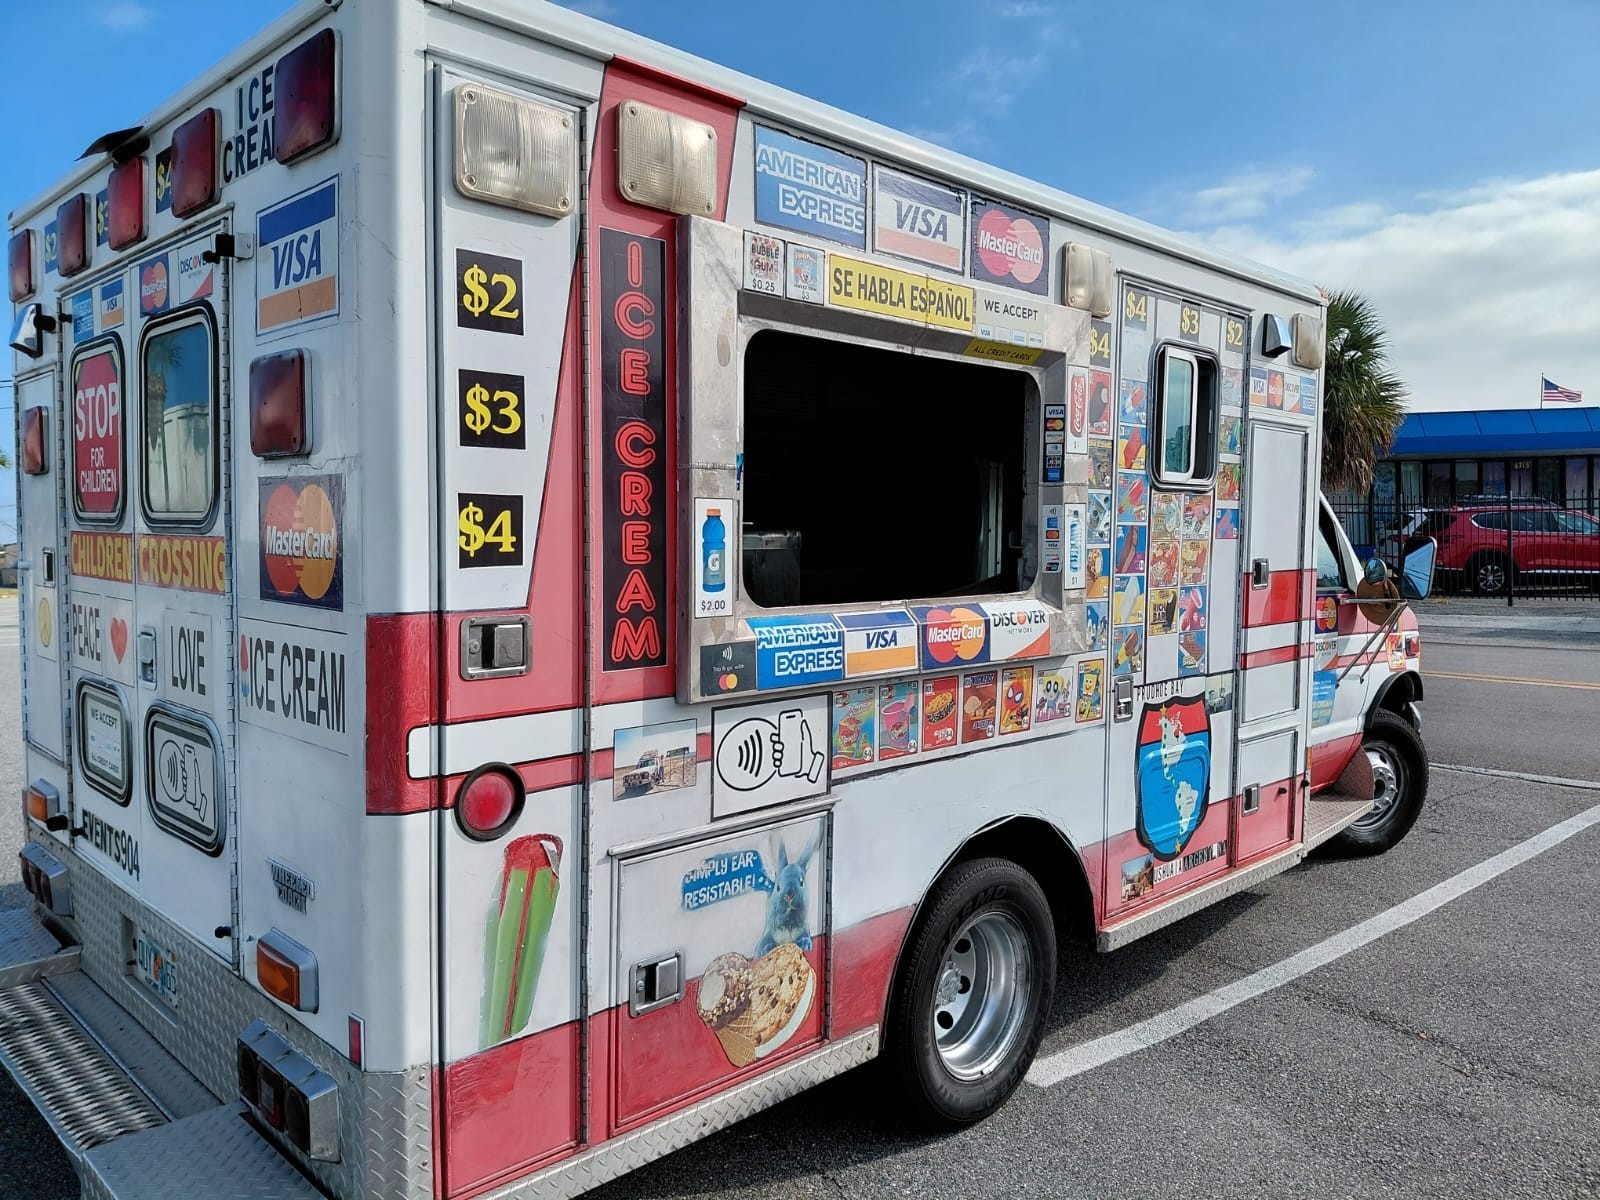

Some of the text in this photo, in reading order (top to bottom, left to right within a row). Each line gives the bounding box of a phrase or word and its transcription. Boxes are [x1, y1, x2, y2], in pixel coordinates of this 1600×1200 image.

[237, 64, 274, 130] ICE
[223, 119, 276, 184] CREA
[756, 143, 860, 200] AMERICAN
[779, 183, 865, 231] EXPRESS
[893, 198, 949, 242] VISA
[271, 229, 322, 289] VISA
[751, 243, 779, 259] BUBBLE
[979, 228, 1043, 265] MasterCard
[180, 254, 206, 274] DISCOV
[754, 259, 773, 272] GUM
[462, 264, 520, 319] $2
[752, 278, 775, 293] $0.25
[801, 290, 810, 300] $3
[833, 266, 971, 322] SE HABLA ESPAÑOL
[984, 299, 1038, 320] WE ACCEPT
[1126, 290, 1147, 322] $4
[1181, 304, 1199, 335] $3
[981, 327, 991, 337] VISA
[1090, 327, 1110, 359] $4
[1226, 319, 1244, 346] $2
[974, 346, 1032, 361] ALL CREDIT CARDS
[75, 382, 121, 442] STOP
[464, 383, 522, 436] $3
[1048, 408, 1065, 416] VISA
[90, 446, 105, 468] FOR
[611, 239, 661, 662] ICE CREAM
[80, 467, 118, 494] CHILDREN
[265, 525, 336, 561] MasterCard
[458, 502, 518, 558] $4
[71, 531, 226, 591] CHILDREN CROSSING
[701, 599, 726, 612] $2.00
[992, 609, 1047, 628] DISCOVER
[757, 623, 840, 650] AMERICAN
[864, 631, 899, 649] VISA
[928, 621, 986, 644] MasterCard
[72, 603, 206, 696] PEACE LOVE
[775, 646, 843, 676] EXPRESS
[249, 637, 347, 734] ICE CREAM
[1170, 679, 1184, 696] BAY
[81, 808, 140, 882] EVENTS904
[731, 851, 758, 872] EAR-
[684, 873, 756, 910] RESISTABLE!
